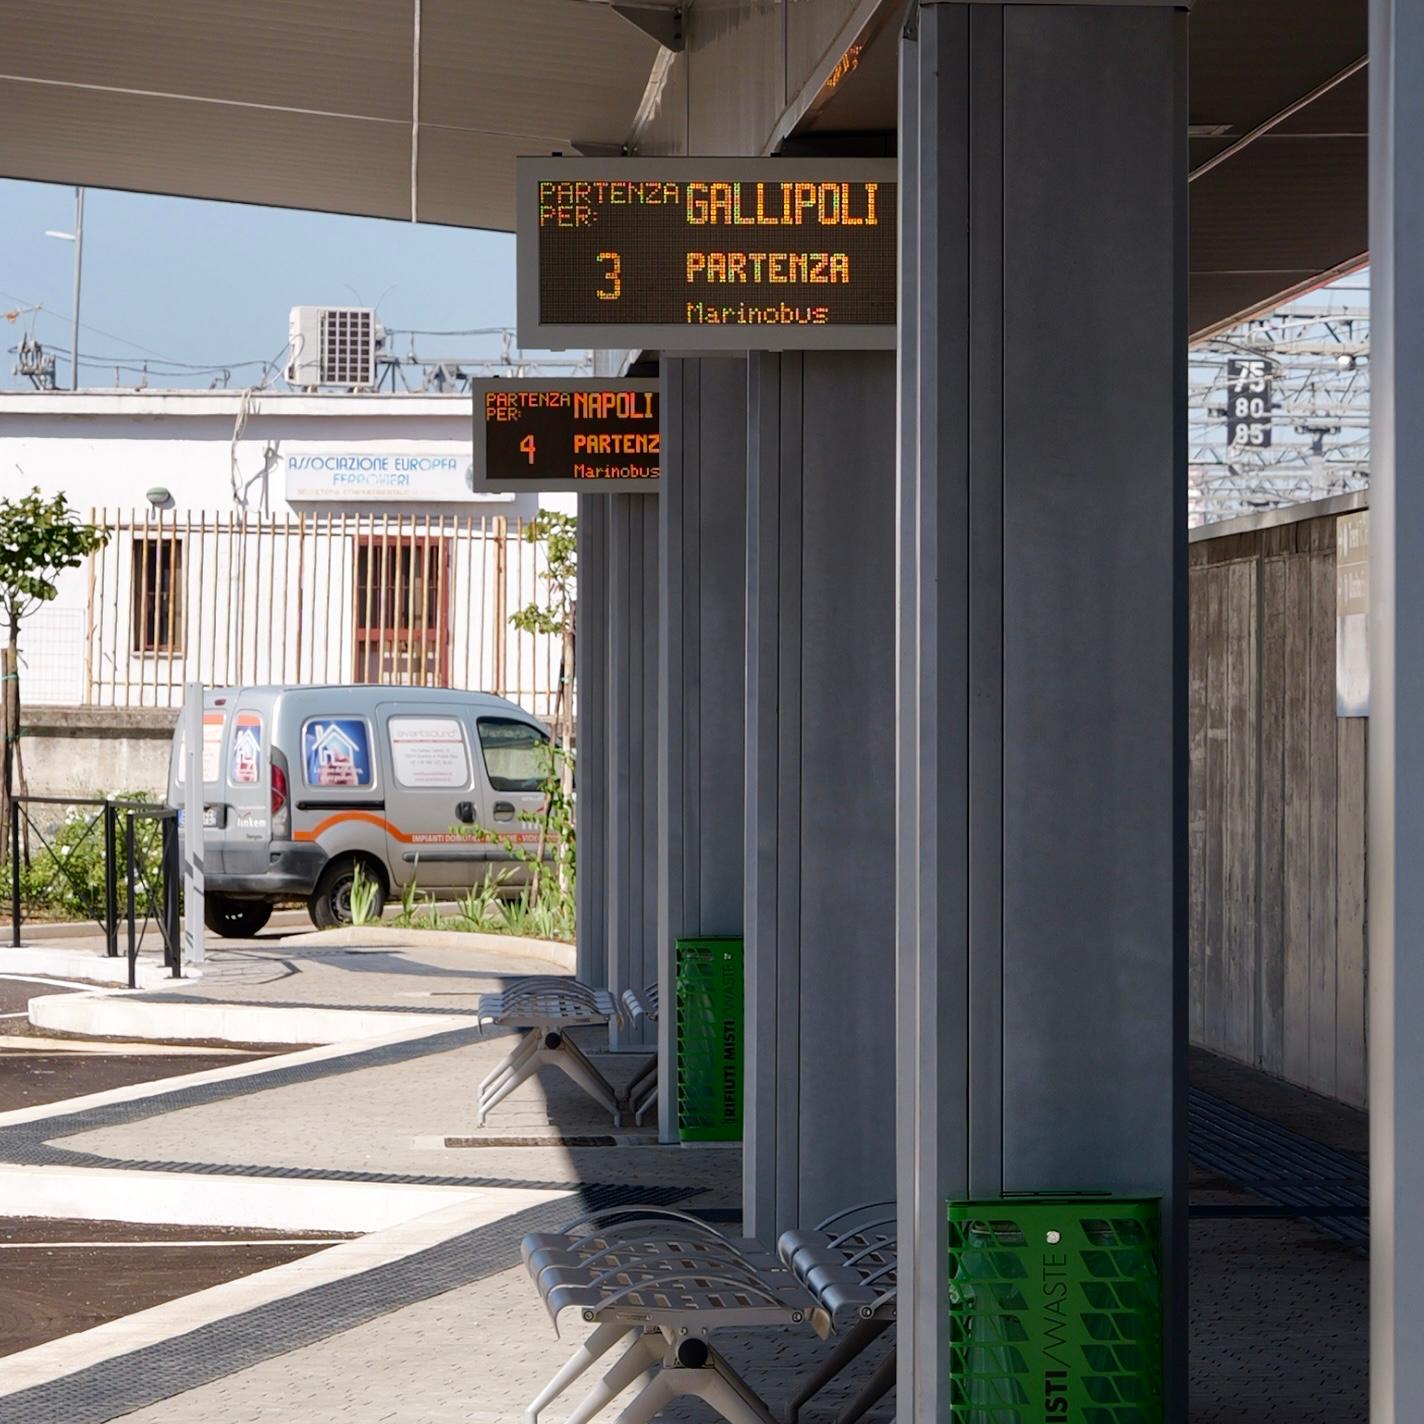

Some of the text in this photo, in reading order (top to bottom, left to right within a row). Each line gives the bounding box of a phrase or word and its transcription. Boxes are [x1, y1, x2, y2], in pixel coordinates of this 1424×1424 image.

[540, 182, 679, 204] PARTENZA
[686, 182, 878, 225] GALLIPOLI
[540, 205, 598, 227] PER:
[596, 252, 621, 300] 3
[686, 252, 850, 284] PARTENZA
[687, 302, 829, 324] Marinobus
[1234, 361, 1265, 393] 75
[486, 393, 571, 407] PARTENZA
[573, 392, 653, 419] NAPOLI
[1235, 397, 1264, 418] 80
[486, 407, 521, 421] PER:
[1235, 423, 1264, 444] 85
[519, 434, 536, 465] 4
[573, 463, 660, 478] Marinobus
[723, 1065, 737, 1121] RIFIUTI
